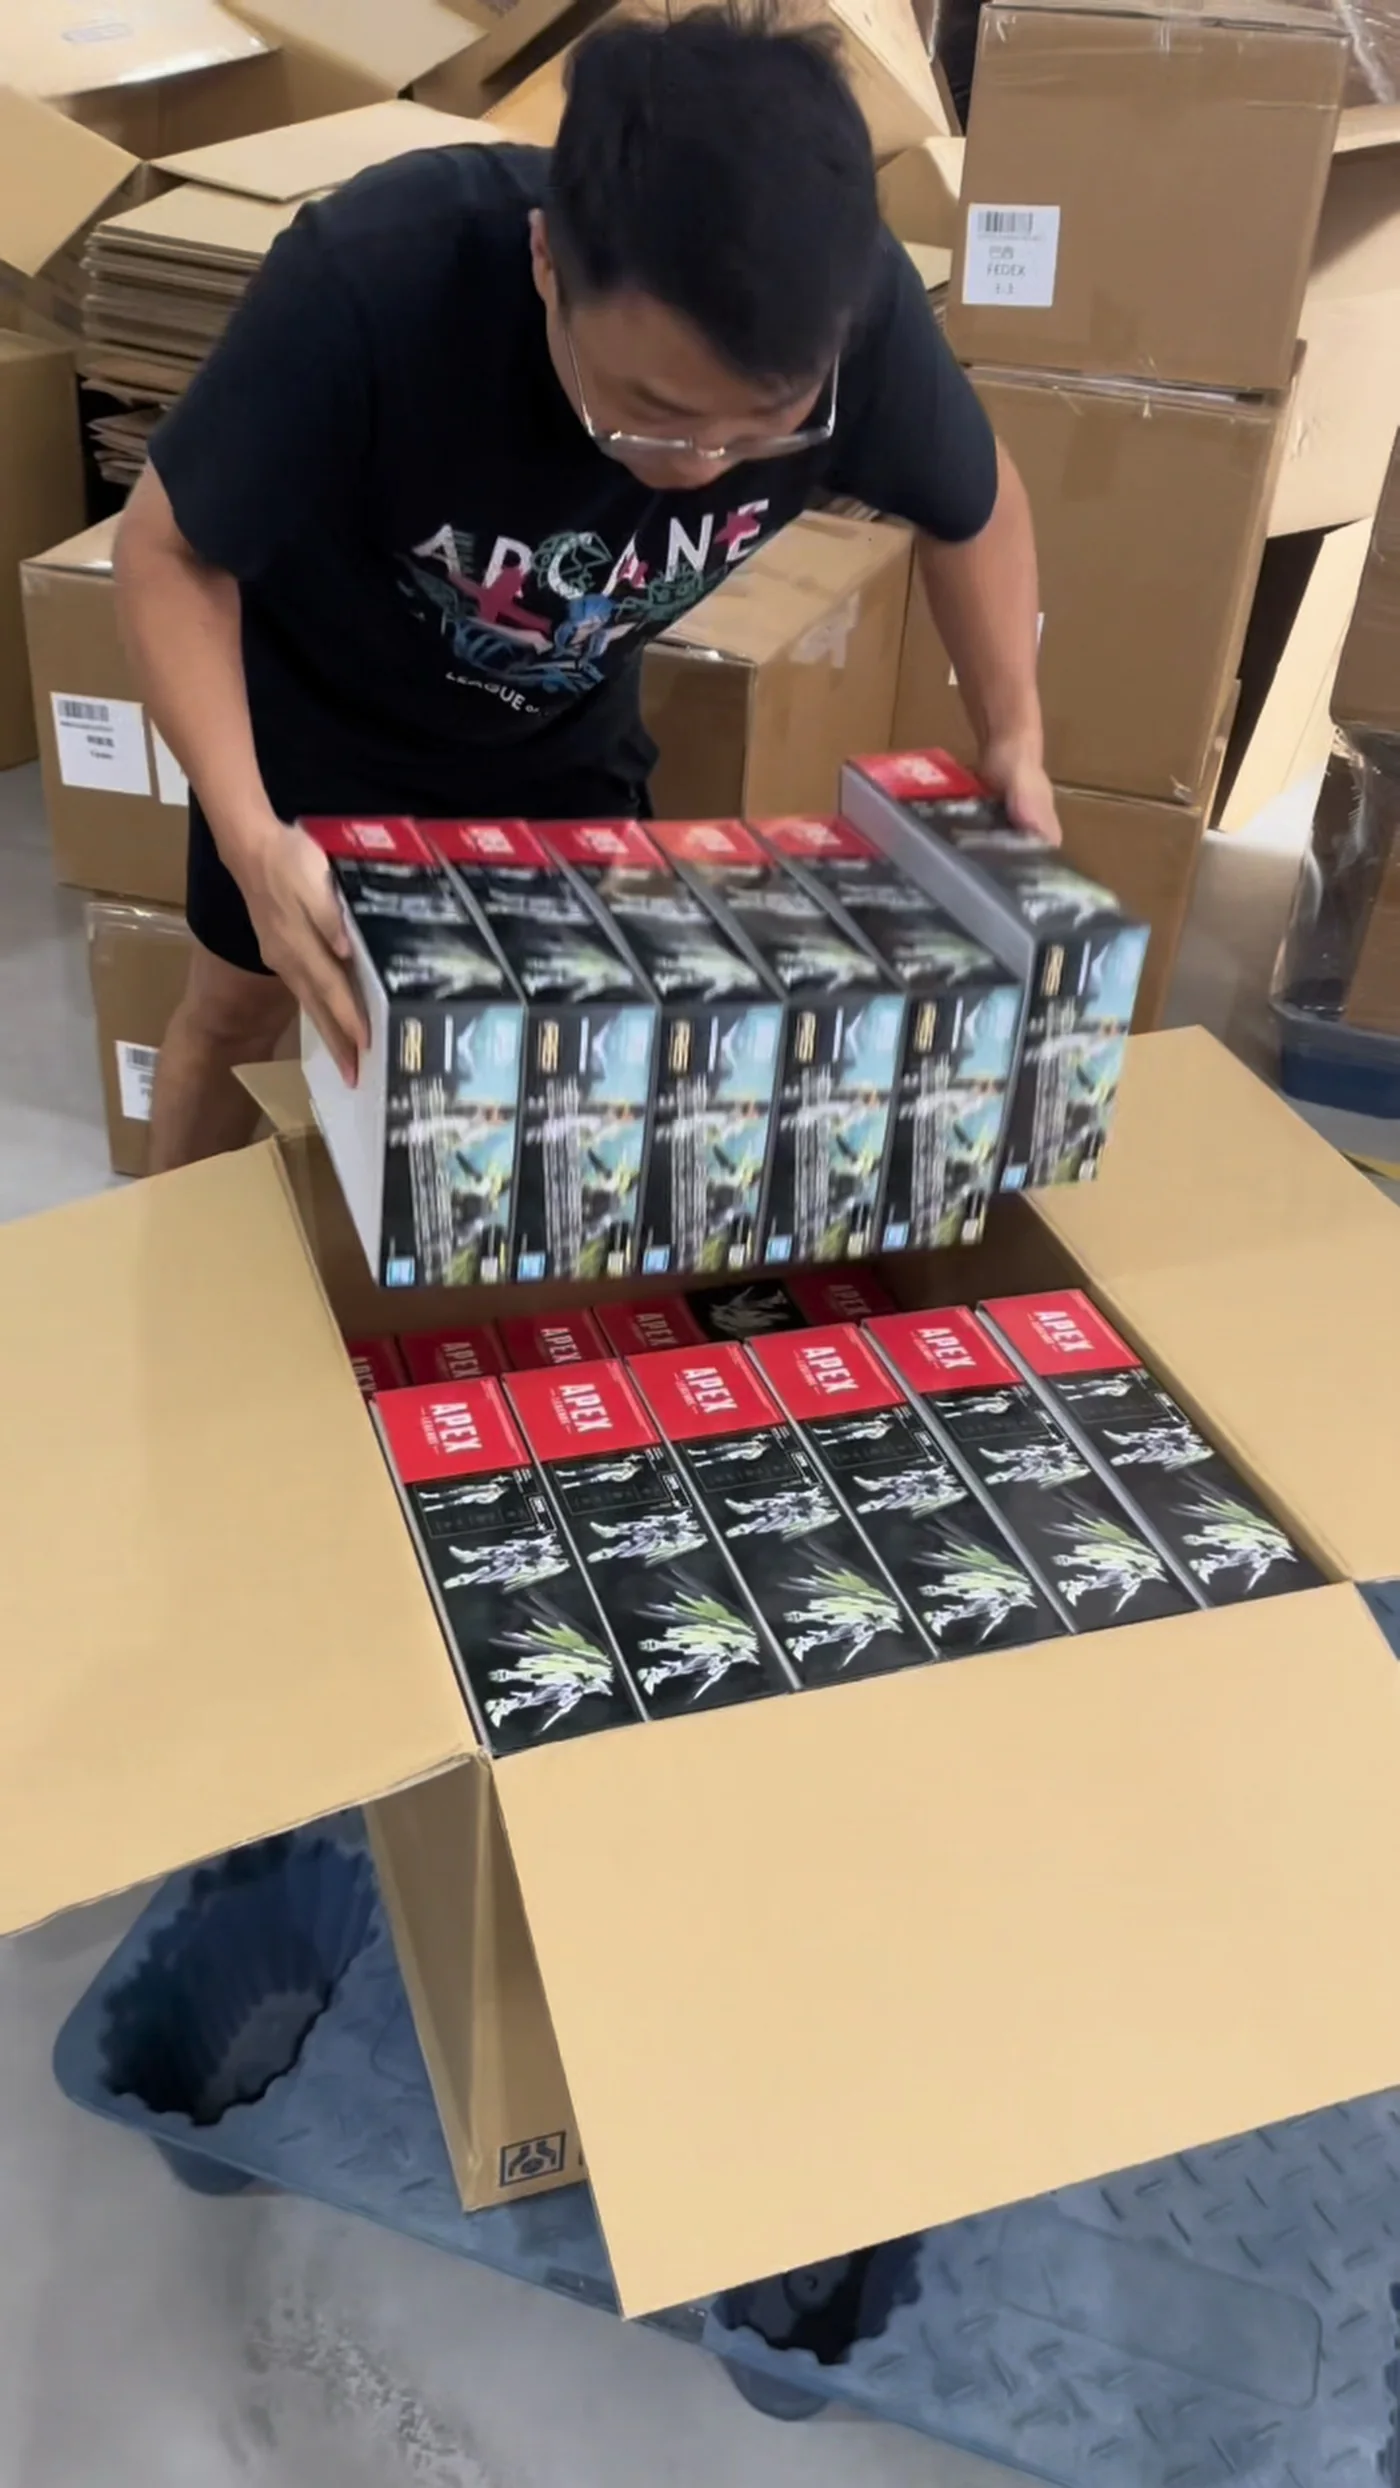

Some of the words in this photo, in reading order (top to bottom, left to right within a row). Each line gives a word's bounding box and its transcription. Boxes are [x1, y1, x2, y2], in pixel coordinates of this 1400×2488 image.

[541, 1327, 582, 1364] APEX
[636, 1313, 679, 1346] APEX
[916, 1328, 977, 1369] APEX
[1033, 1311, 1095, 1352] APEX
[441, 1342, 484, 1378] APEX
[801, 1346, 859, 1394] APEX
[558, 1383, 613, 1433] APEX
[681, 1367, 738, 1413] APEX
[429, 1402, 483, 1453] APEX
